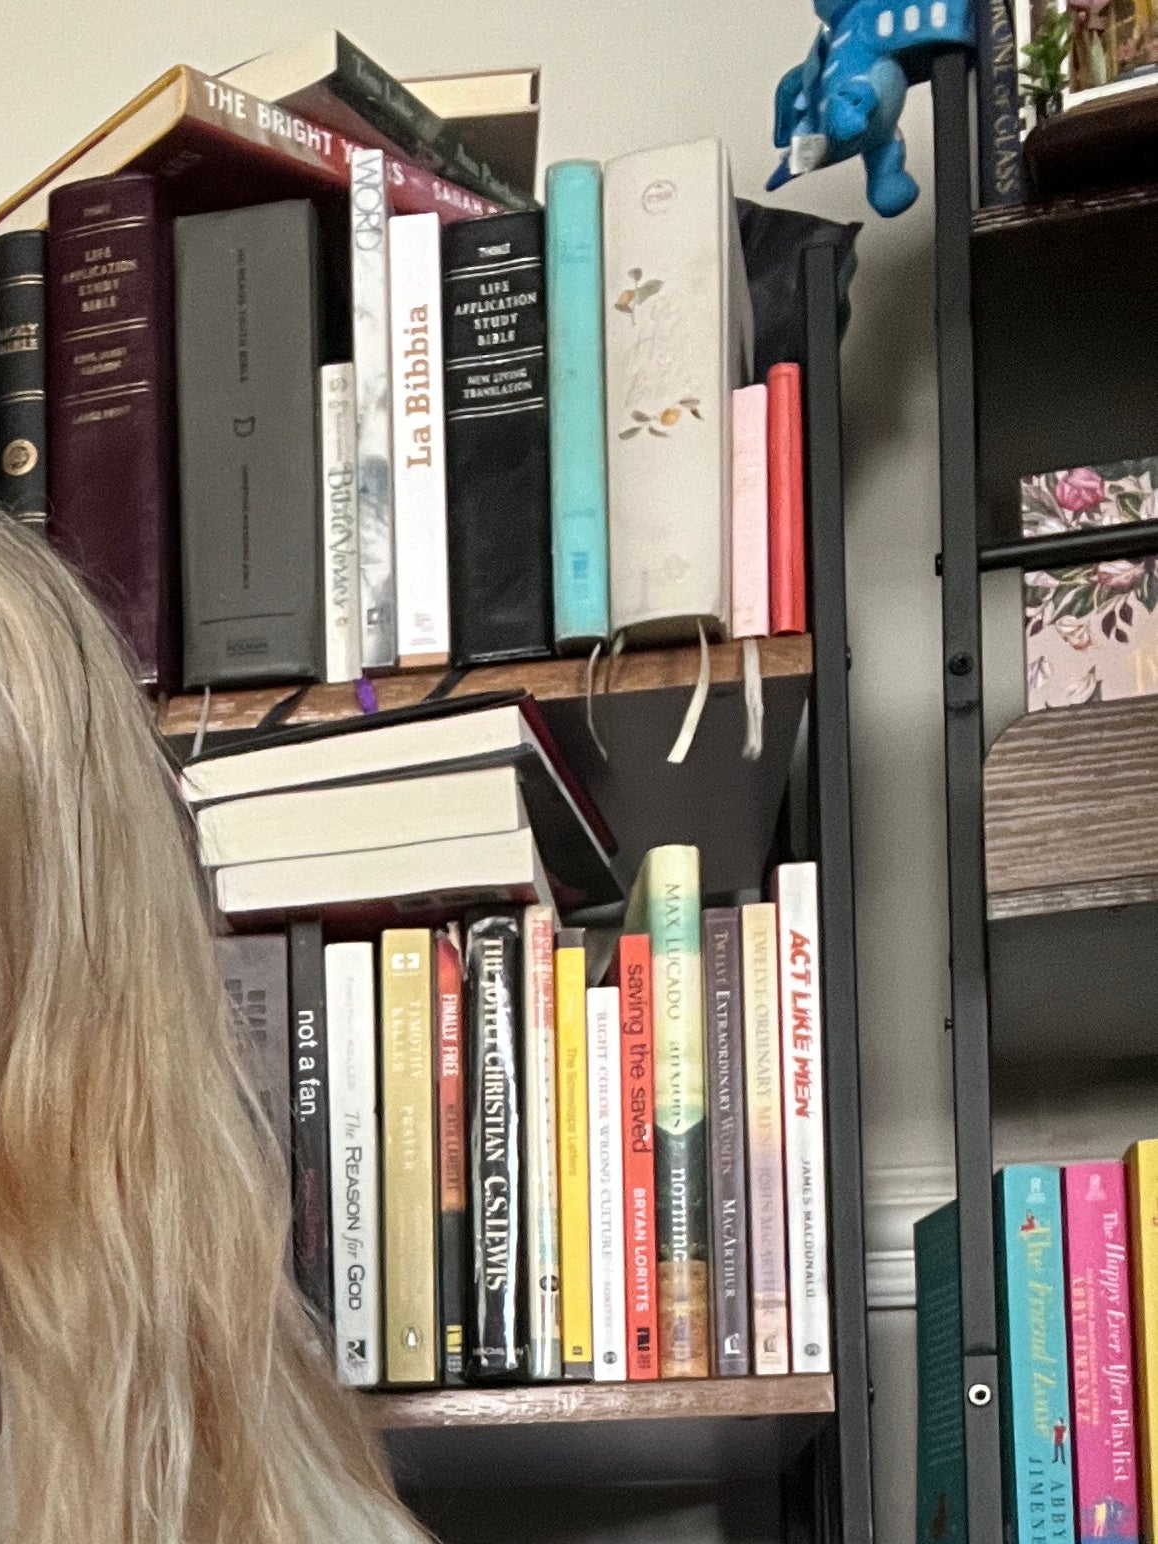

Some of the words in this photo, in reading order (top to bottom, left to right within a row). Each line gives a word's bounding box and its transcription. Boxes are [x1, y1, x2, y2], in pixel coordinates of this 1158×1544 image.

[203, 81, 247, 120] THE
[256, 102, 333, 156] BRIGHT
[993, 114, 1020, 194] GLASS
[352, 155, 383, 250] WORD
[454, 292, 539, 317] APPLICATION
[480, 281, 510, 297] LIFE
[473, 312, 519, 330] STUDY
[476, 330, 517, 347] BIBLE
[402, 302, 431, 417] Bibbia
[406, 423, 433, 470] La
[663, 882, 683, 928] MAX
[481, 936, 505, 971] THE
[665, 937, 684, 1021] LUCADO
[713, 929, 730, 986] TWELVE
[752, 926, 770, 998] TWELVE
[789, 929, 813, 985] ACT
[441, 993, 459, 1042] FINALLY
[624, 963, 647, 1035] saving
[790, 990, 814, 1051] LIKE
[297, 1009, 319, 1049] not
[391, 1007, 406, 1073] KELLER
[595, 1009, 609, 1059] RIGHT
[714, 989, 732, 1112] EXTRAORDINARY
[754, 1001, 772, 1099] ORDINARY
[298, 1056, 315, 1071] a
[442, 1046, 459, 1077] FREE
[566, 1047, 578, 1069] The
[630, 1042, 650, 1079] the
[299, 1077, 322, 1123] fan.
[484, 1052, 507, 1162] CHRISTIAN
[565, 1071, 579, 1132] Screwtape
[597, 1065, 611, 1120] COLOR
[792, 1055, 816, 1119] MEN
[345, 1111, 362, 1140] The
[400, 1104, 416, 1171] PRAYER
[630, 1087, 652, 1154] saved
[719, 1115, 735, 1176] WOMEN
[756, 1105, 773, 1147] MEN
[567, 1134, 580, 1177] Letters
[598, 1124, 612, 1184] WRONG
[801, 1157, 814, 1206] JAMES
[344, 1146, 363, 1231] REASON
[632, 1187, 648, 1241] BRYAN
[342, 1234, 364, 1259] for
[599, 1188, 613, 1259] CULTURE
[1019, 1221, 1052, 1272] The
[1103, 1210, 1120, 1240] The
[634, 1246, 650, 1313] LORITTS
[802, 1210, 817, 1298] MACDONALD
[1099, 1242, 1126, 1304] Happy
[346, 1264, 366, 1311] GOD
[1072, 1275, 1088, 1322] ABBY
[1106, 1308, 1127, 1354] Ever
[1101, 1363, 1129, 1405] After
[1104, 1408, 1132, 1482] Playlist
[1049, 1480, 1068, 1541] ABBY
